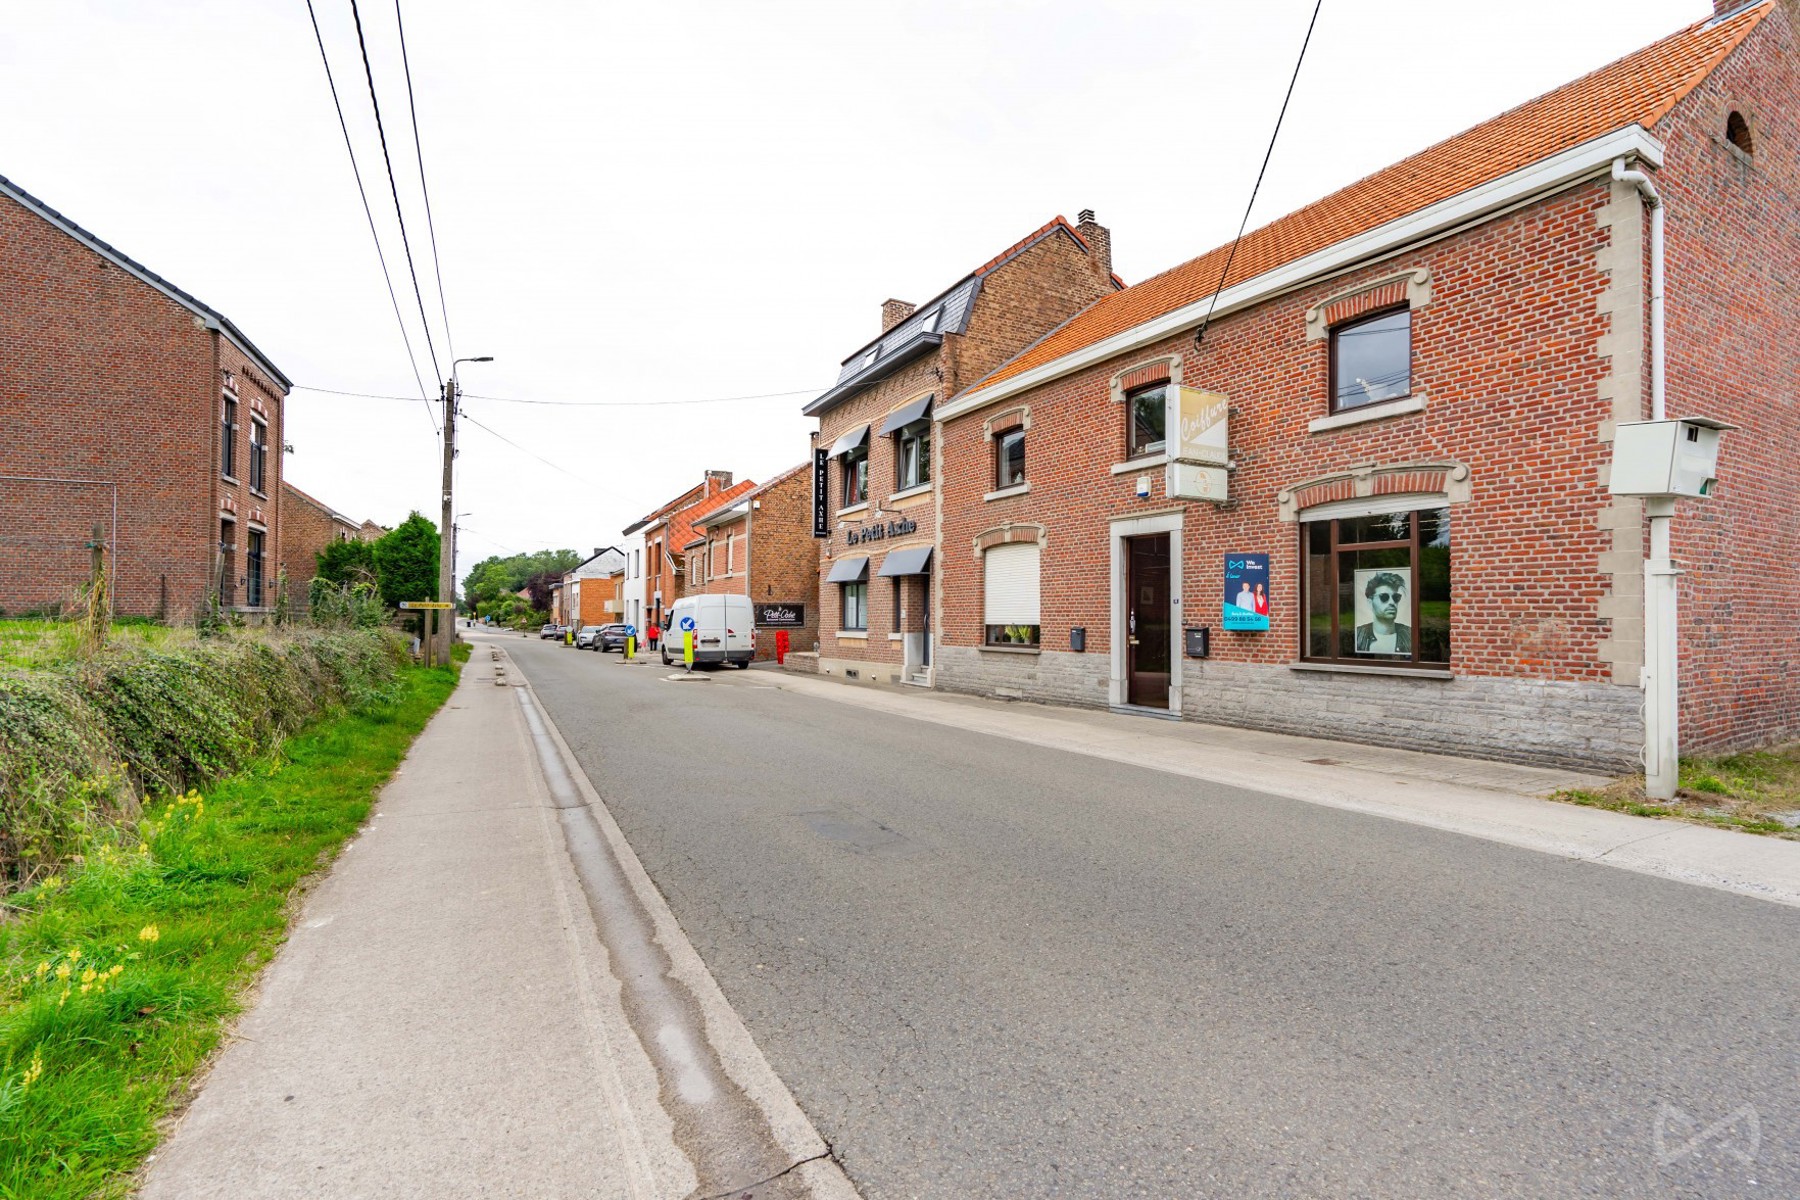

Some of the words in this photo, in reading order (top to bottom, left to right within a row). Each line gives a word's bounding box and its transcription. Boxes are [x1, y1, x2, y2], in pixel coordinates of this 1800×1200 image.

[1181, 398, 1228, 442] Coiffure
[819, 453, 825, 466] LE
[846, 529, 859, 546] Le
[861, 523, 885, 544] Petit
[887, 517, 918, 538] Axhe
